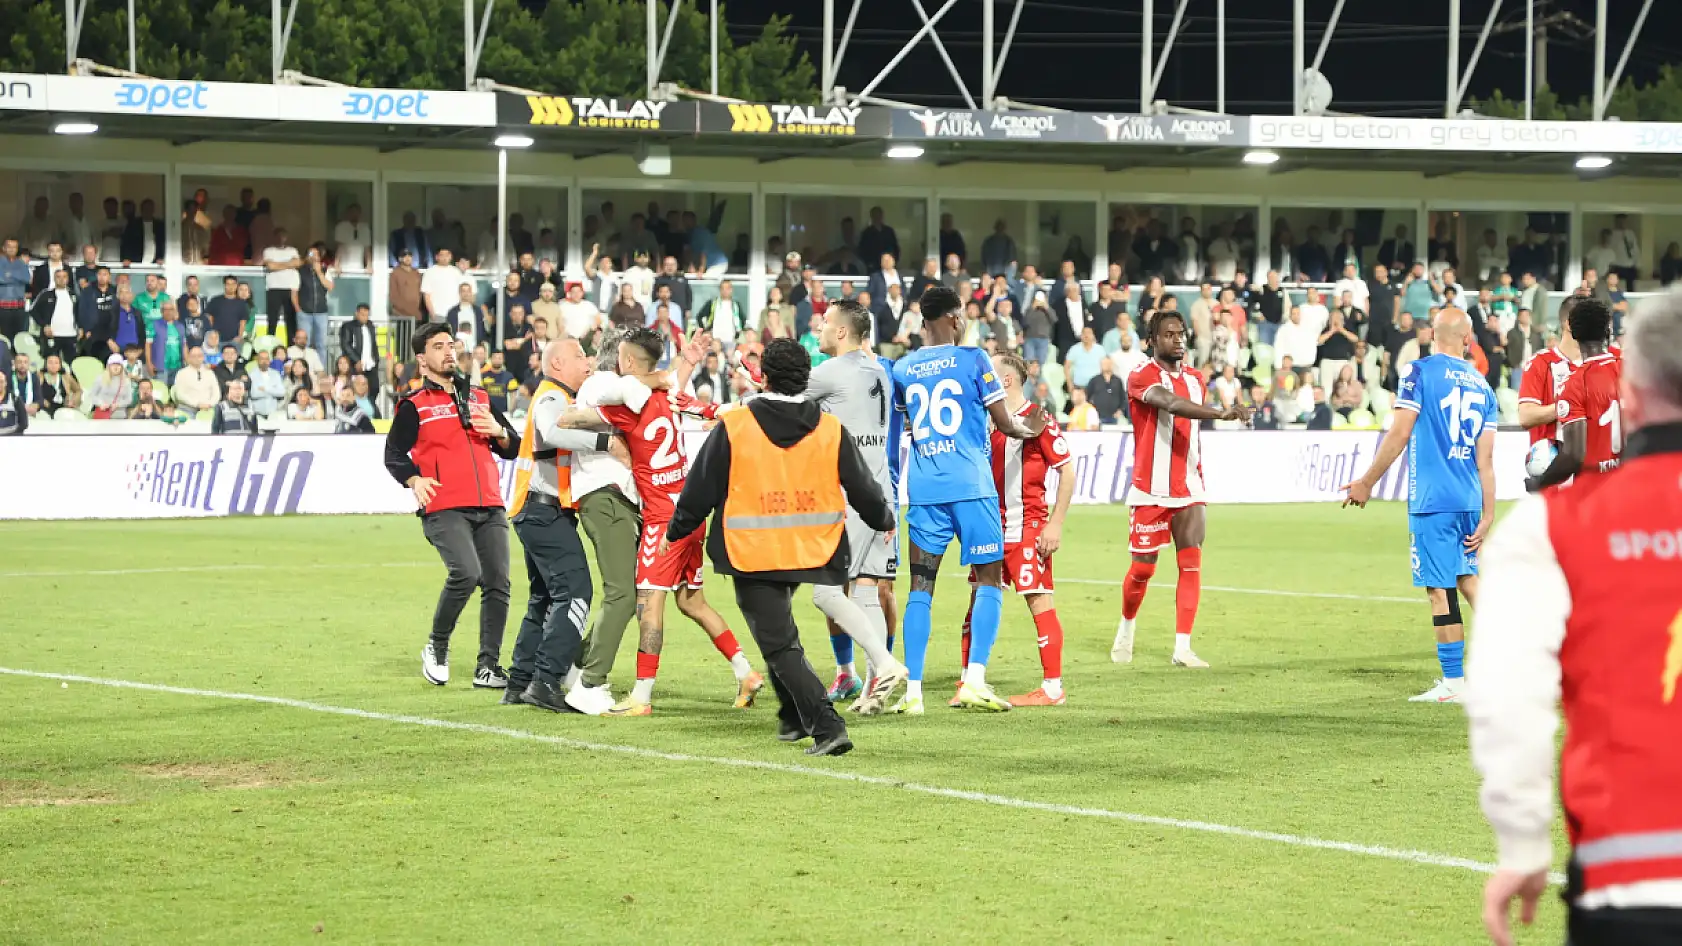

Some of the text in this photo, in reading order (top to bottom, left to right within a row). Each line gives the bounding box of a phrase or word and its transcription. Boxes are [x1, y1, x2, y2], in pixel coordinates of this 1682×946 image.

[0, 81, 32, 99] n
[115, 81, 208, 112] opet
[342, 89, 429, 120] opet
[572, 98, 667, 119] TALAY
[771, 105, 862, 125] TALAY
[578, 116, 660, 129] LOGISTICS
[777, 123, 856, 135] LOGISTICS
[938, 119, 985, 137] AURA
[990, 113, 1057, 131] ACROPOL
[1120, 123, 1164, 140] AURA
[1170, 118, 1234, 135] ACROPOL
[1260, 117, 1411, 143] grey beton
[1430, 123, 1578, 147] grey beton
[906, 356, 958, 377] ACROPOL
[869, 376, 886, 428] 1
[905, 378, 963, 441] 26
[1440, 385, 1486, 447] 15
[853, 434, 878, 448] KAN
[150, 448, 224, 511] Rent
[1308, 443, 1361, 494] Rent
[1608, 530, 1682, 561] SPO
[1018, 563, 1034, 587] 5
